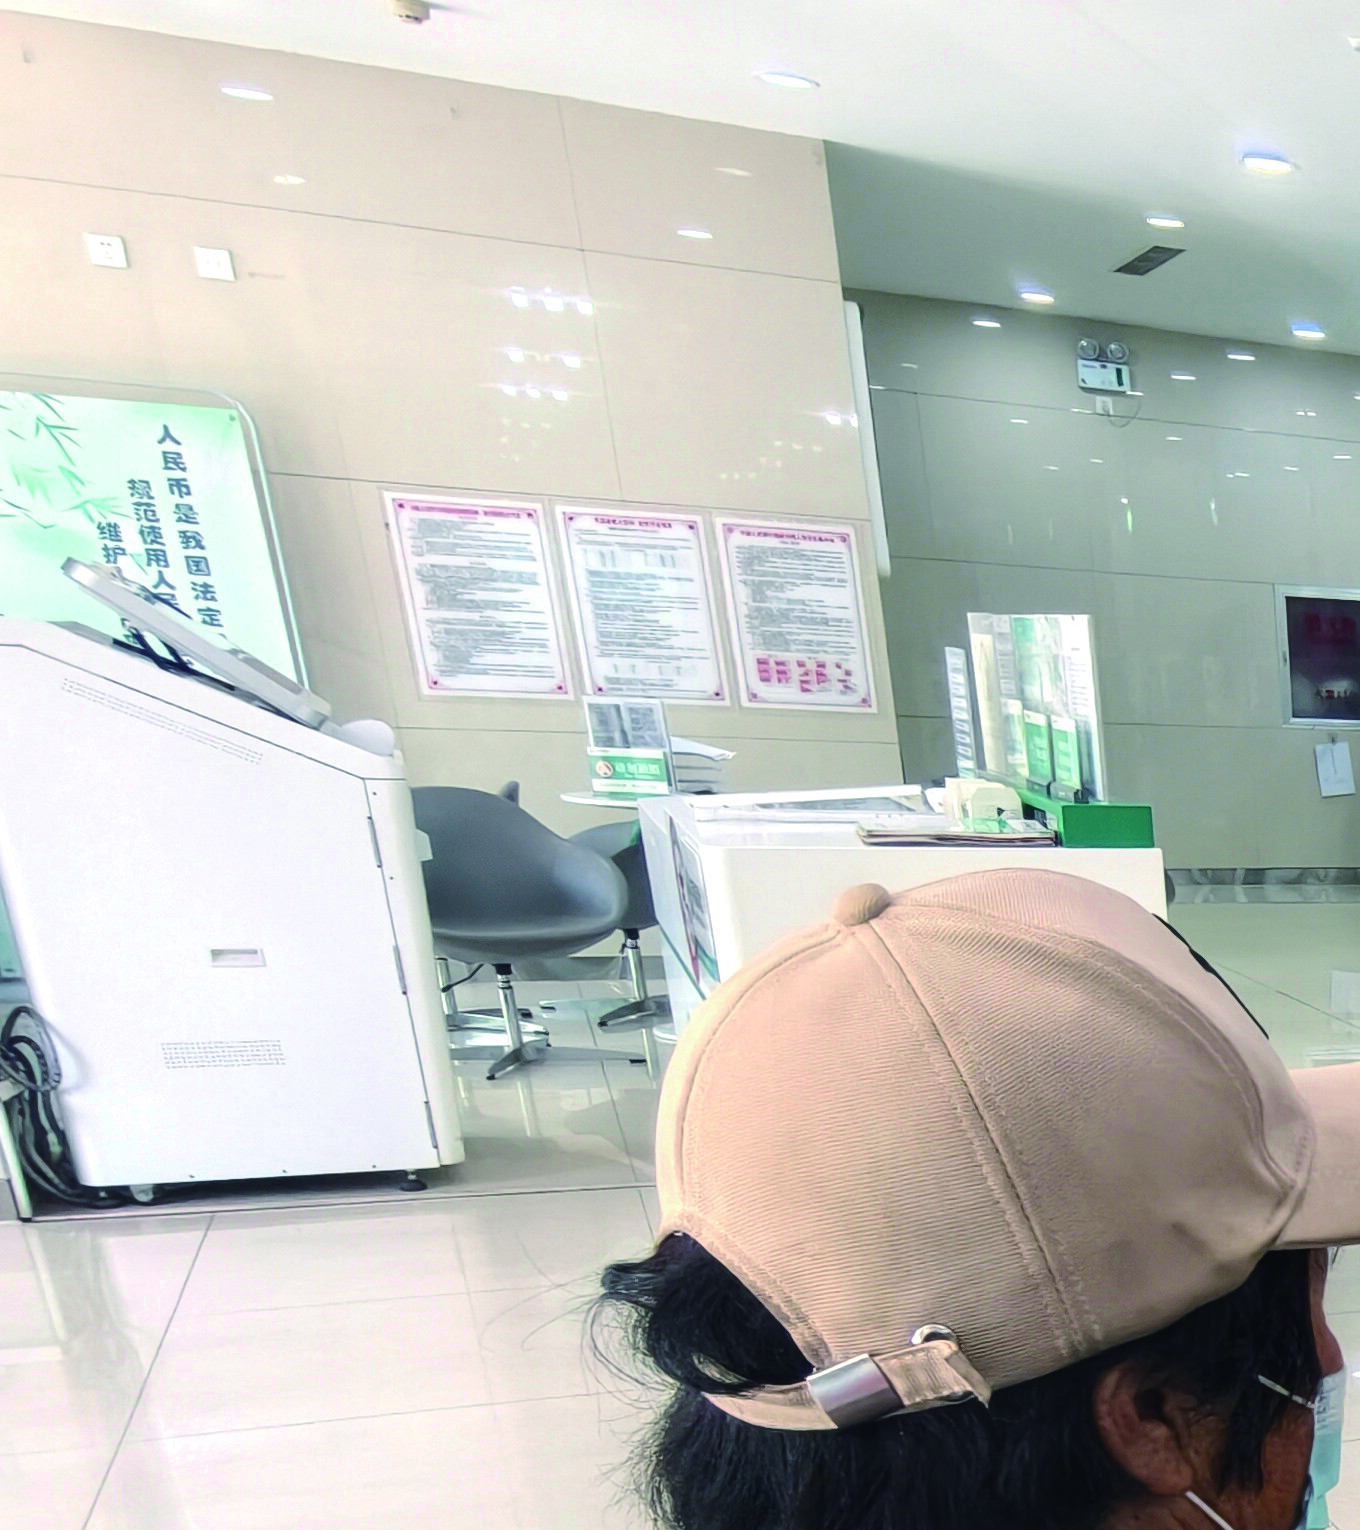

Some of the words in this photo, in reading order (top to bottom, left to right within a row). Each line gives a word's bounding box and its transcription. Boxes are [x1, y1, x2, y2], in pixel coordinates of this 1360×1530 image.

[96, 521, 126, 566] 维护
[157, 424, 226, 630] 人民币是我国法定
